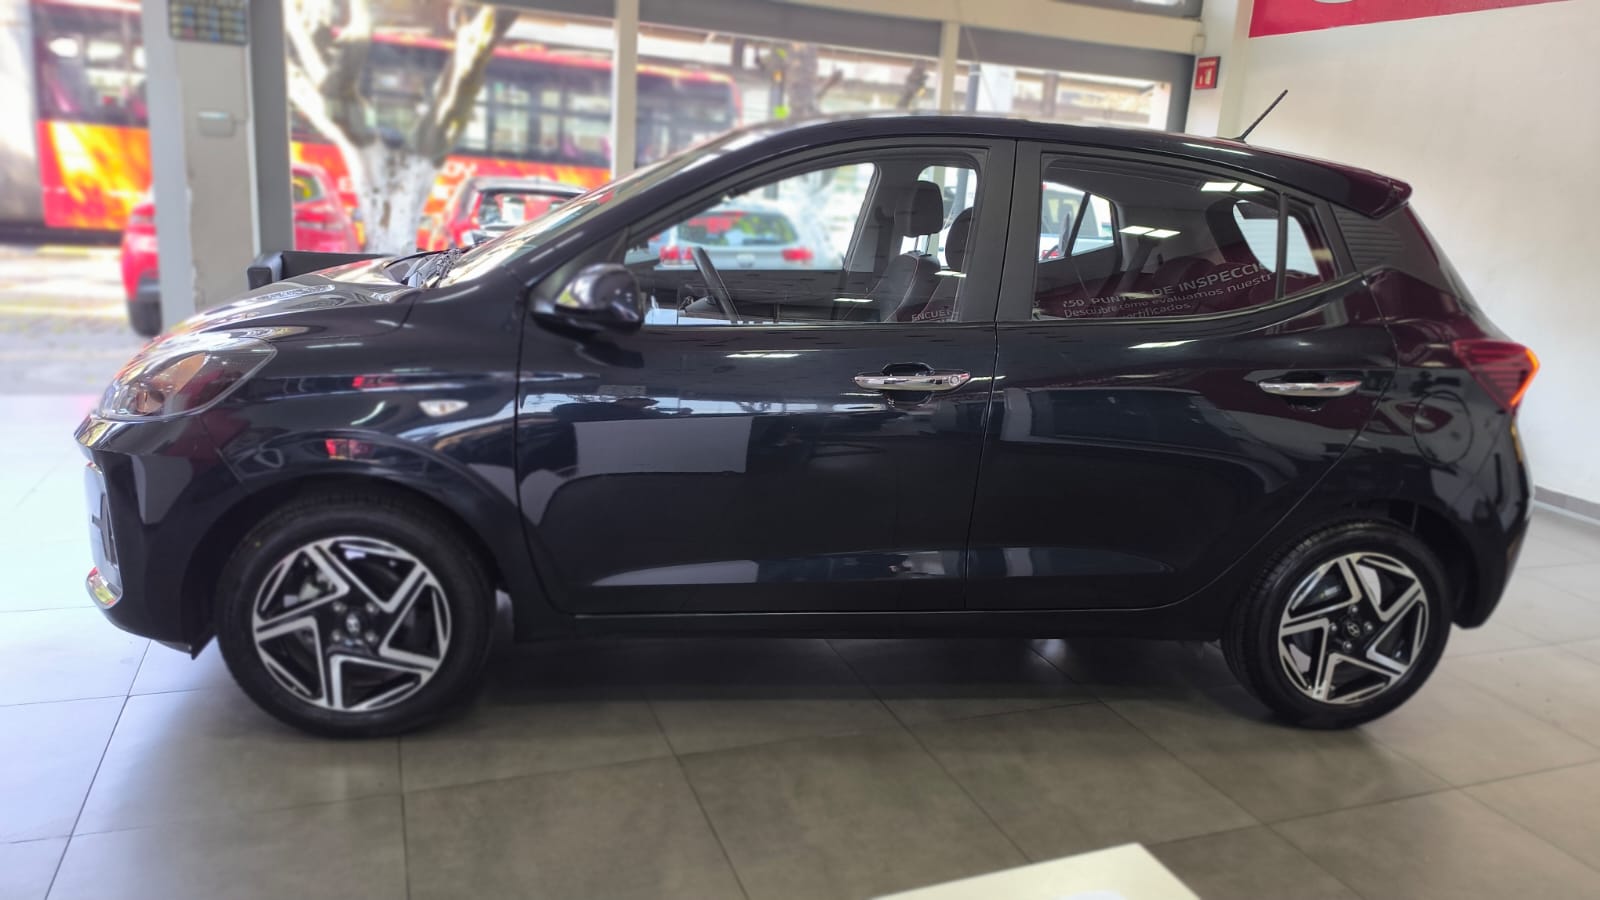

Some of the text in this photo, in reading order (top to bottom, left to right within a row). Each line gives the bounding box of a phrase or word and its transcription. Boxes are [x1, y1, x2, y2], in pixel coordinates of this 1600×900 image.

[1151, 285, 1174, 297] DE
[1063, 303, 1117, 318] Descubre
[1152, 287, 1225, 305] evaluamos
